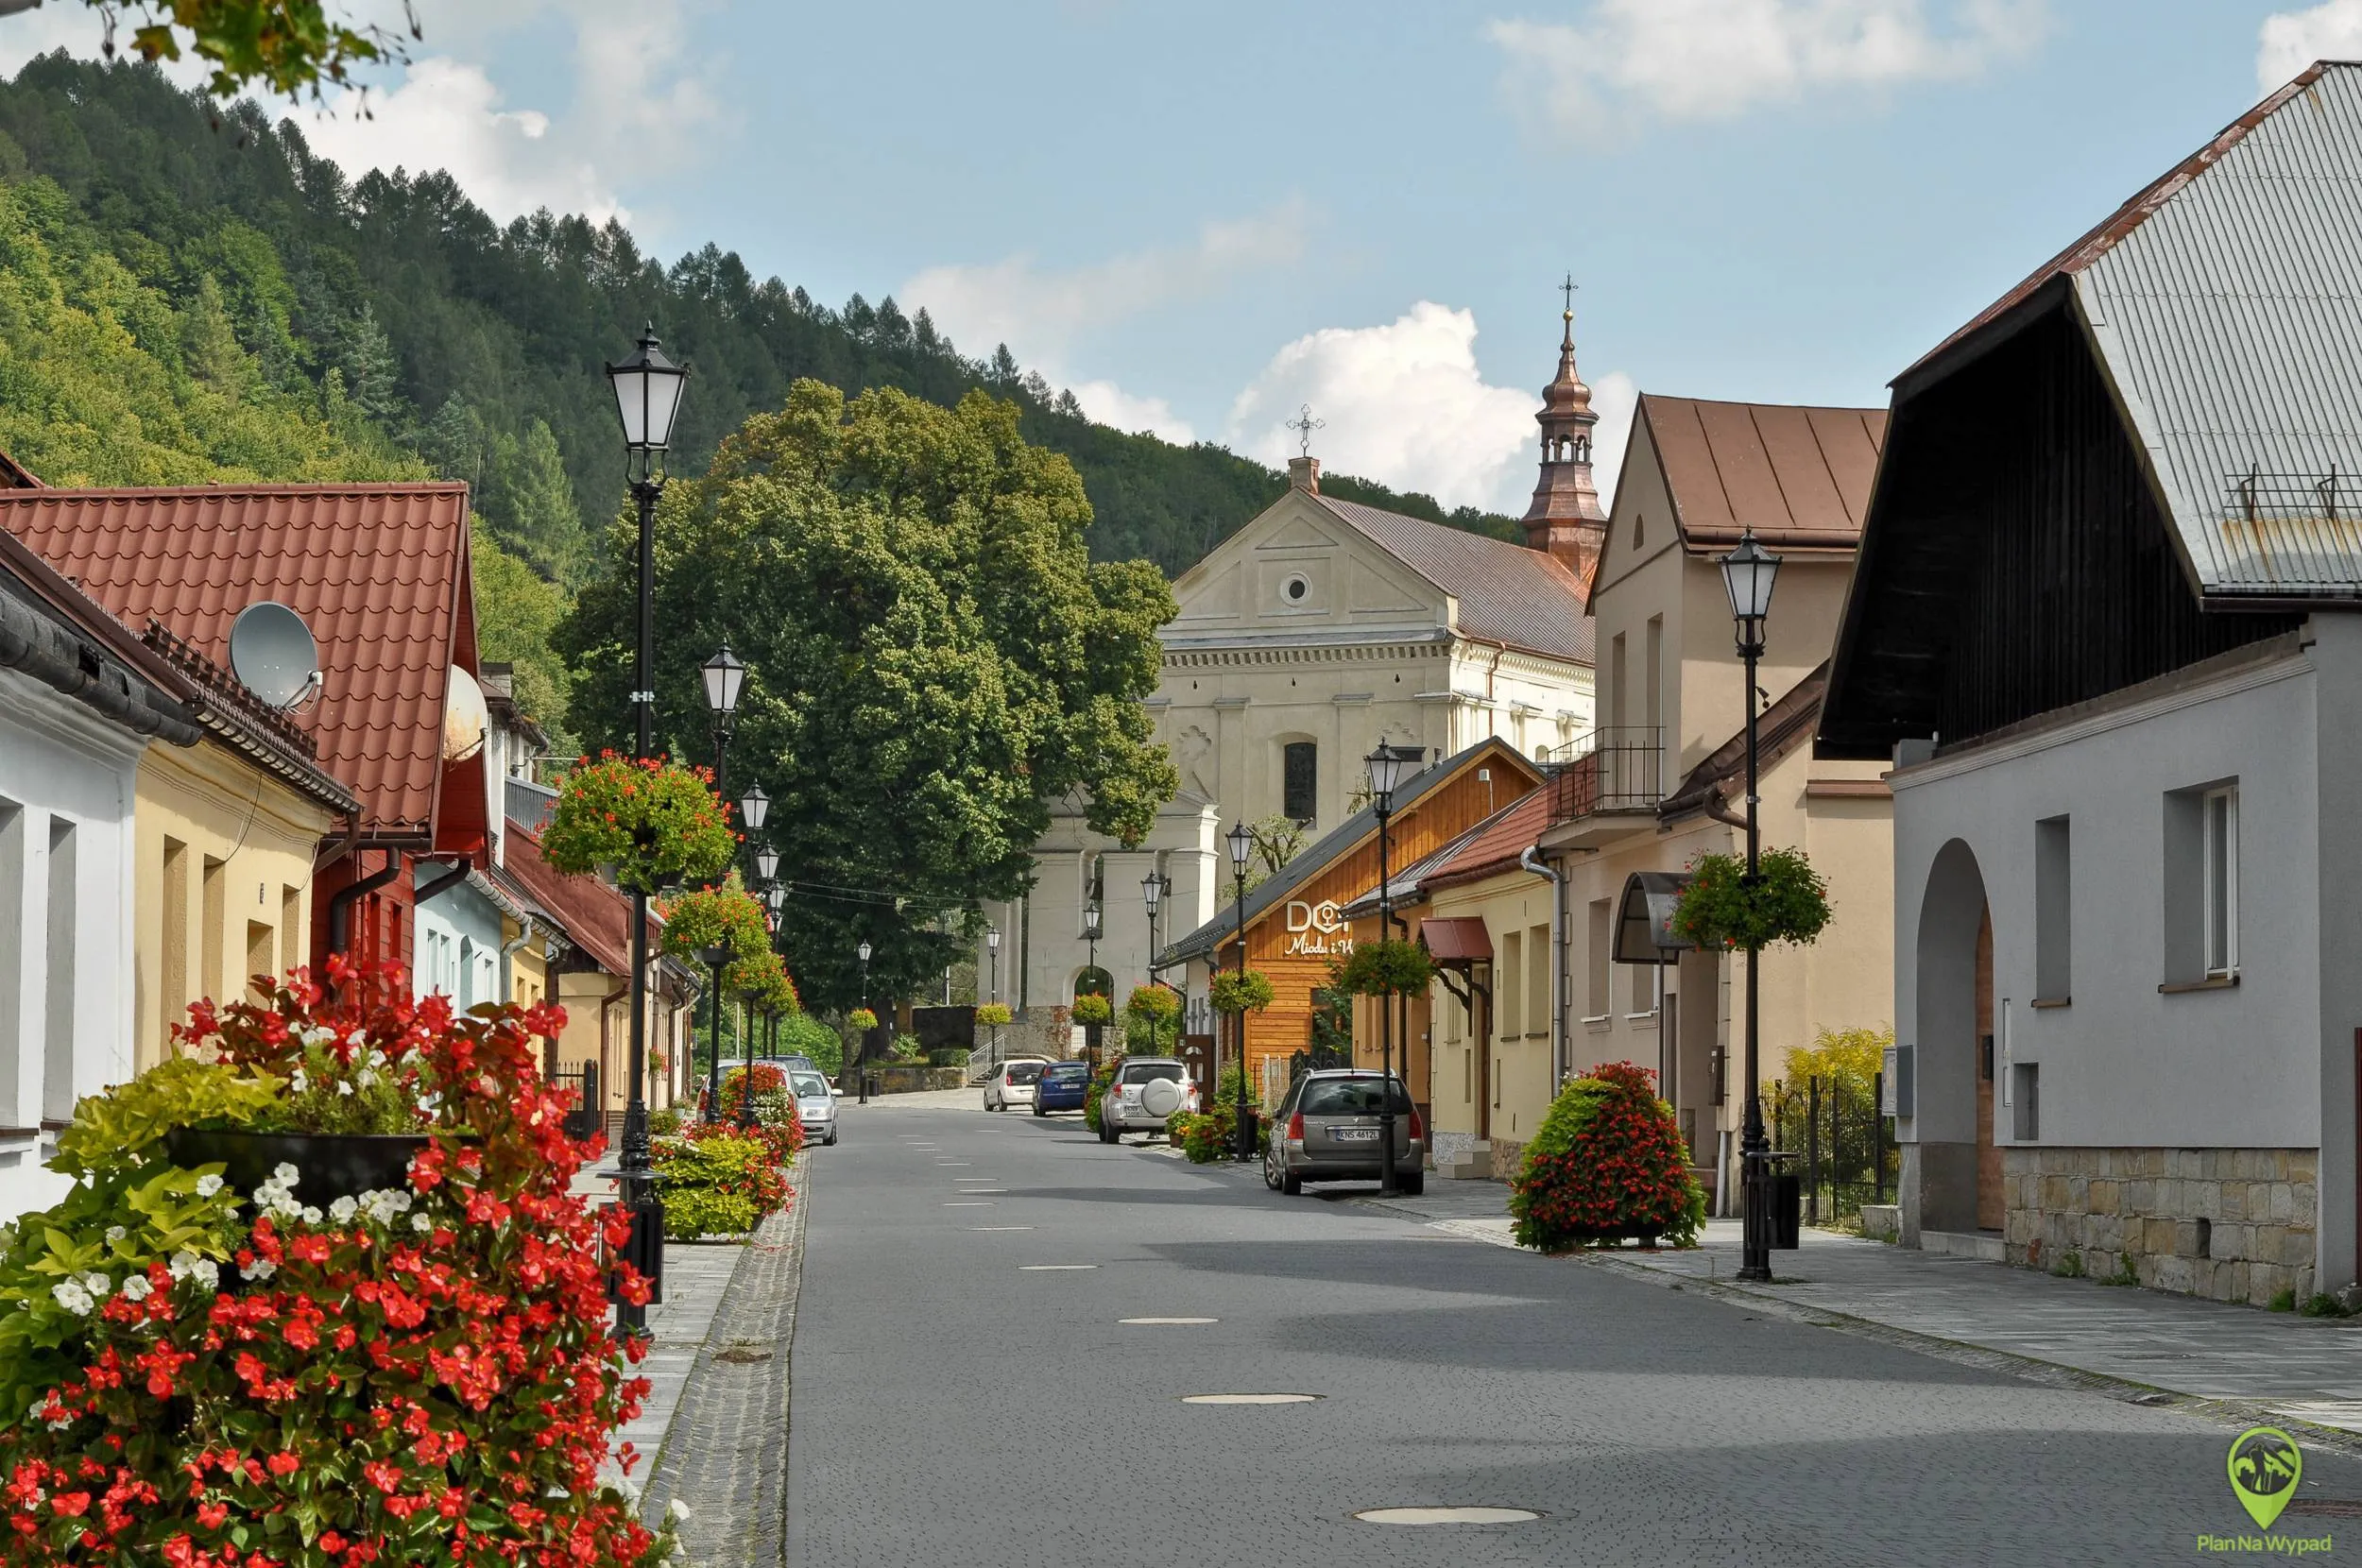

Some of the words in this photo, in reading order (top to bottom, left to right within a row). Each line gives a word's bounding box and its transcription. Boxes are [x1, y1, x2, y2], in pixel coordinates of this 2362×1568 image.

[1287, 900, 1349, 934] DO
[1285, 932, 1328, 955] Miodu
[1330, 943, 1337, 954] i
[1341, 1131, 1355, 1139] KNS
